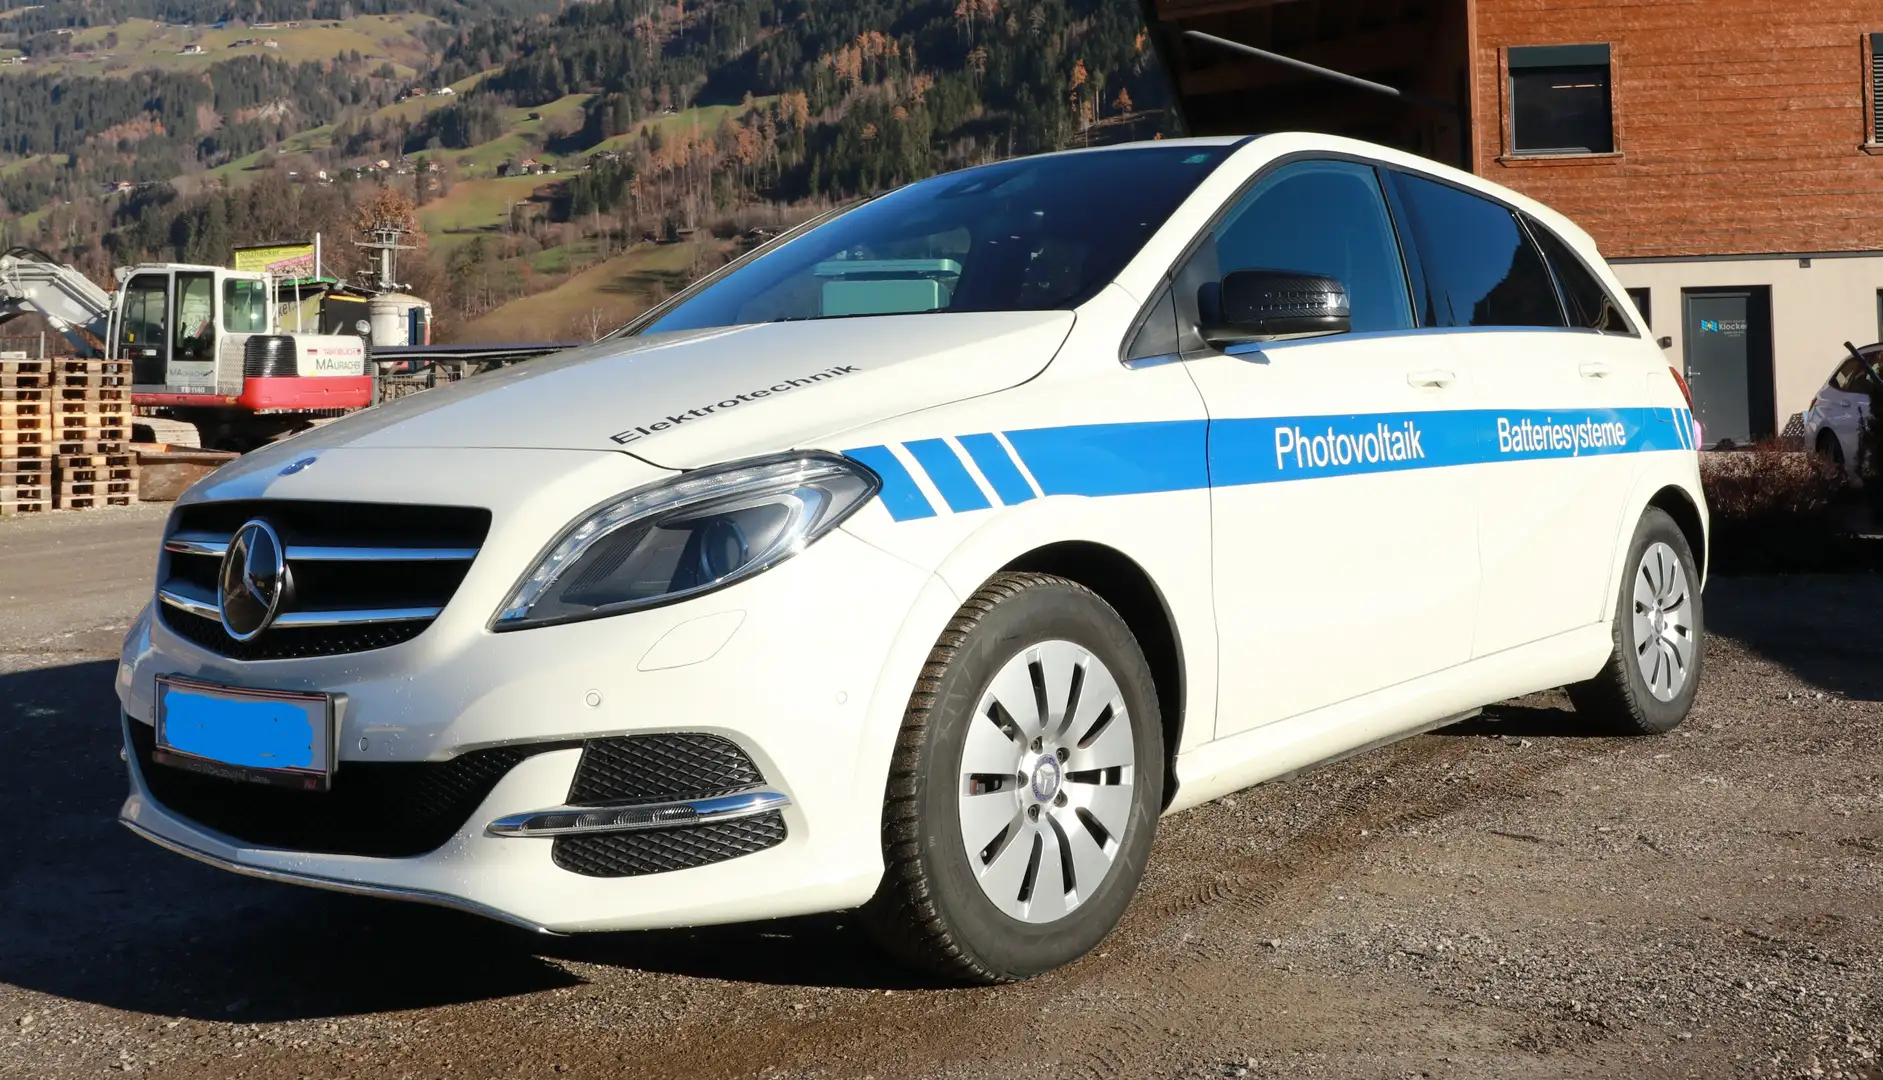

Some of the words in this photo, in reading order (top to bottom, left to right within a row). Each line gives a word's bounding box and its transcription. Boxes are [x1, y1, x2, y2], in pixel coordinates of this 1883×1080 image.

[610, 364, 862, 445] Elektrotechnik
[1275, 421, 1425, 470] Photovoltaik
[1497, 417, 1626, 457] Batteriesysteme
